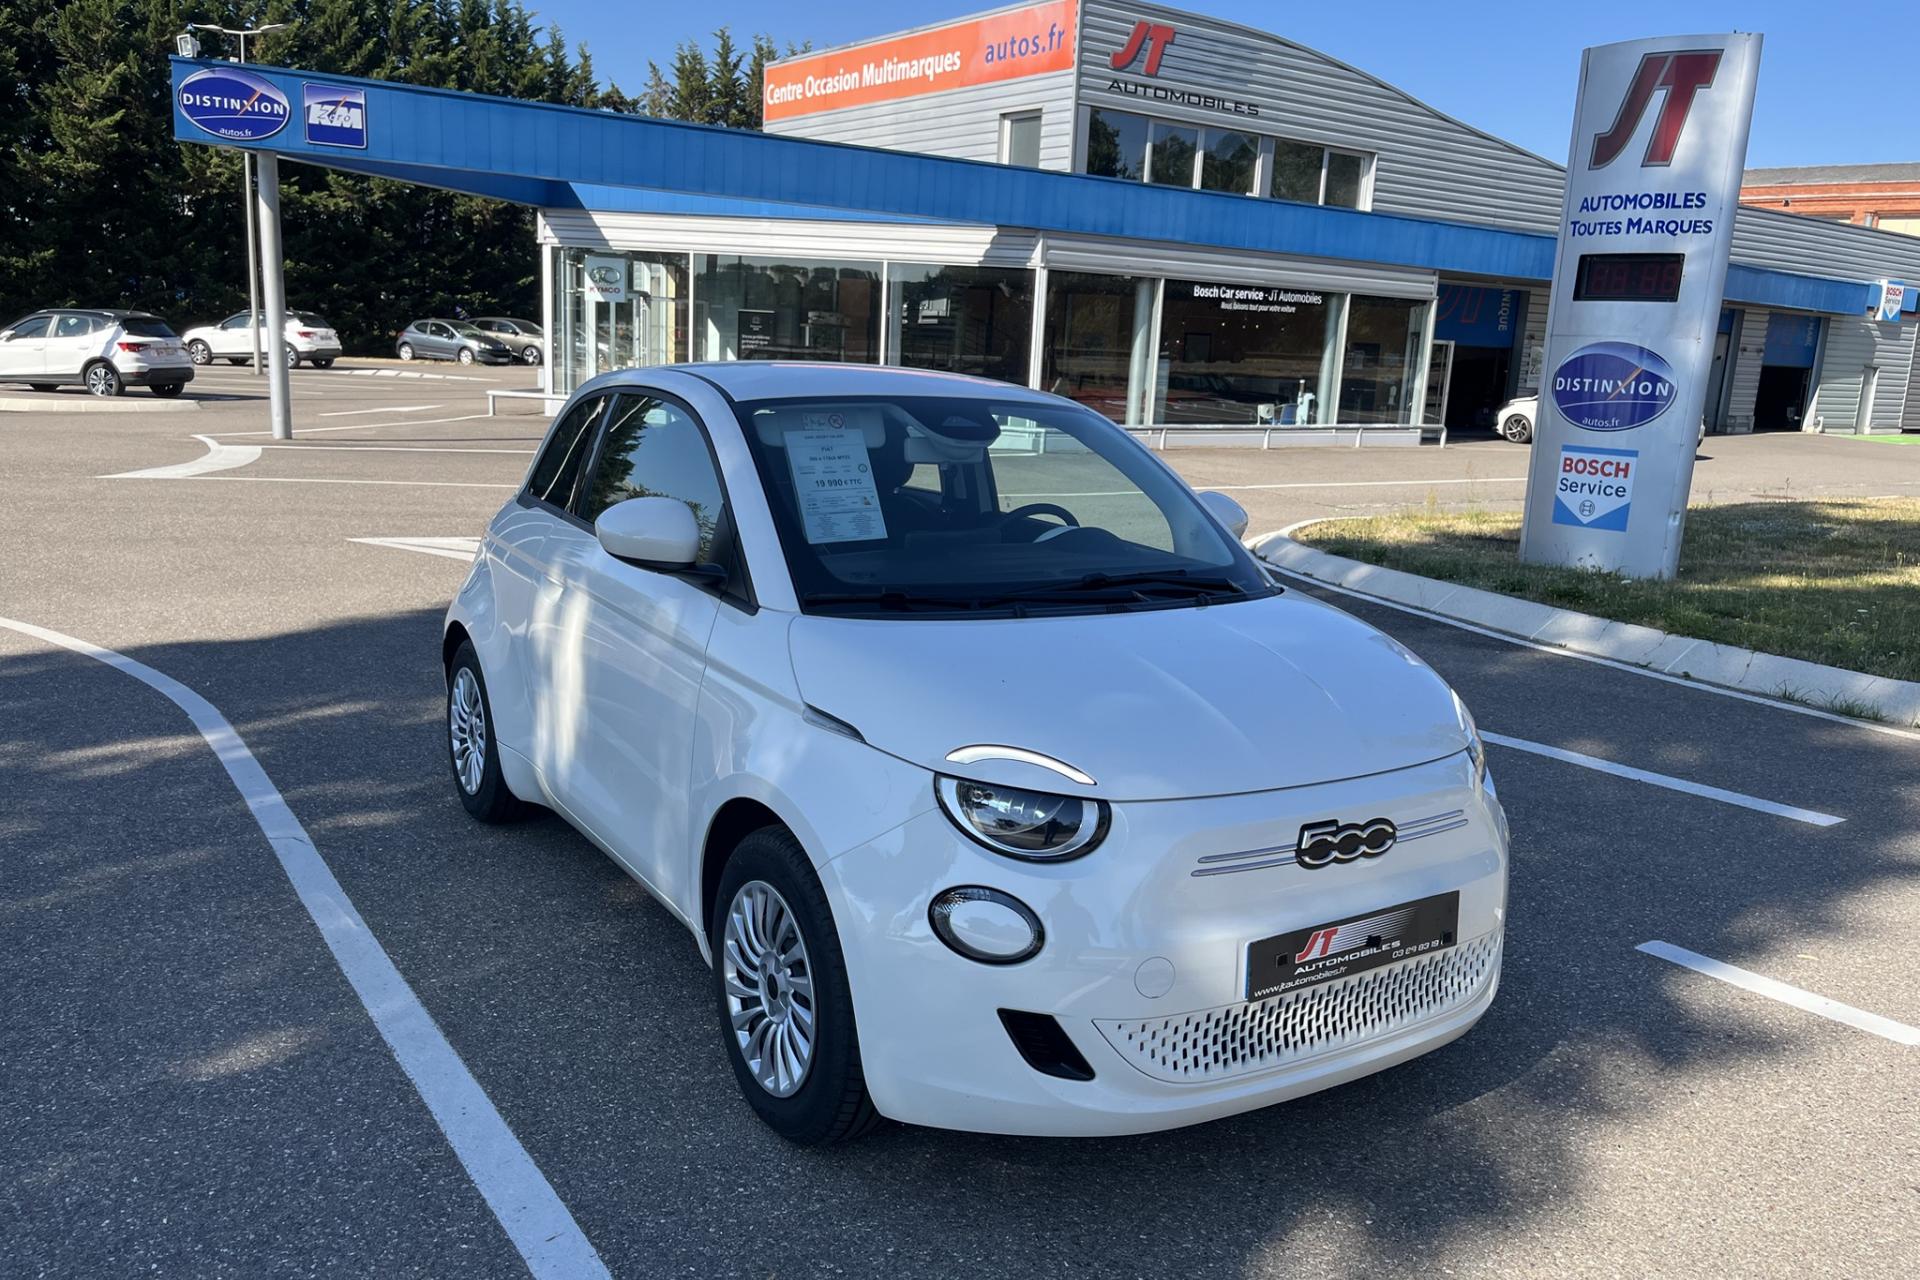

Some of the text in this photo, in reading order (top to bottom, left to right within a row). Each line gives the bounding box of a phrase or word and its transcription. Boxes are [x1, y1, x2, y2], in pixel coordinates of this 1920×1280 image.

[984, 22, 1065, 64] autos.fr
[1109, 20, 1176, 77] JT
[766, 50, 961, 105] Centre Occasion Multimarques
[182, 93, 285, 116] DISTINXION
[1107, 79, 1260, 116] AUTOMOBILES
[1588, 48, 1725, 171] JT
[219, 127, 252, 138] autos.fr
[1578, 192, 1707, 213] AUTOMOBILES
[589, 286, 621, 294] KYMCO
[1193, 285, 1219, 299] Bosch
[1219, 287, 1235, 299] Car
[1235, 288, 1264, 301] service
[1268, 289, 1279, 301] JT
[1279, 291, 1322, 305] Automobiles
[1884, 295, 1901, 306] Service
[1886, 287, 1902, 297] BOSCH
[1555, 377, 1669, 397] DISTINXION
[1582, 416, 1620, 427] autos.fr
[1562, 457, 1630, 479] BOSCH
[1558, 477, 1627, 498] Service
[1297, 817, 1397, 869] 500
[1295, 927, 1339, 964] JT
[1392, 949, 1405, 959] 03
[1293, 939, 1402, 976] AUTOMOBILES
